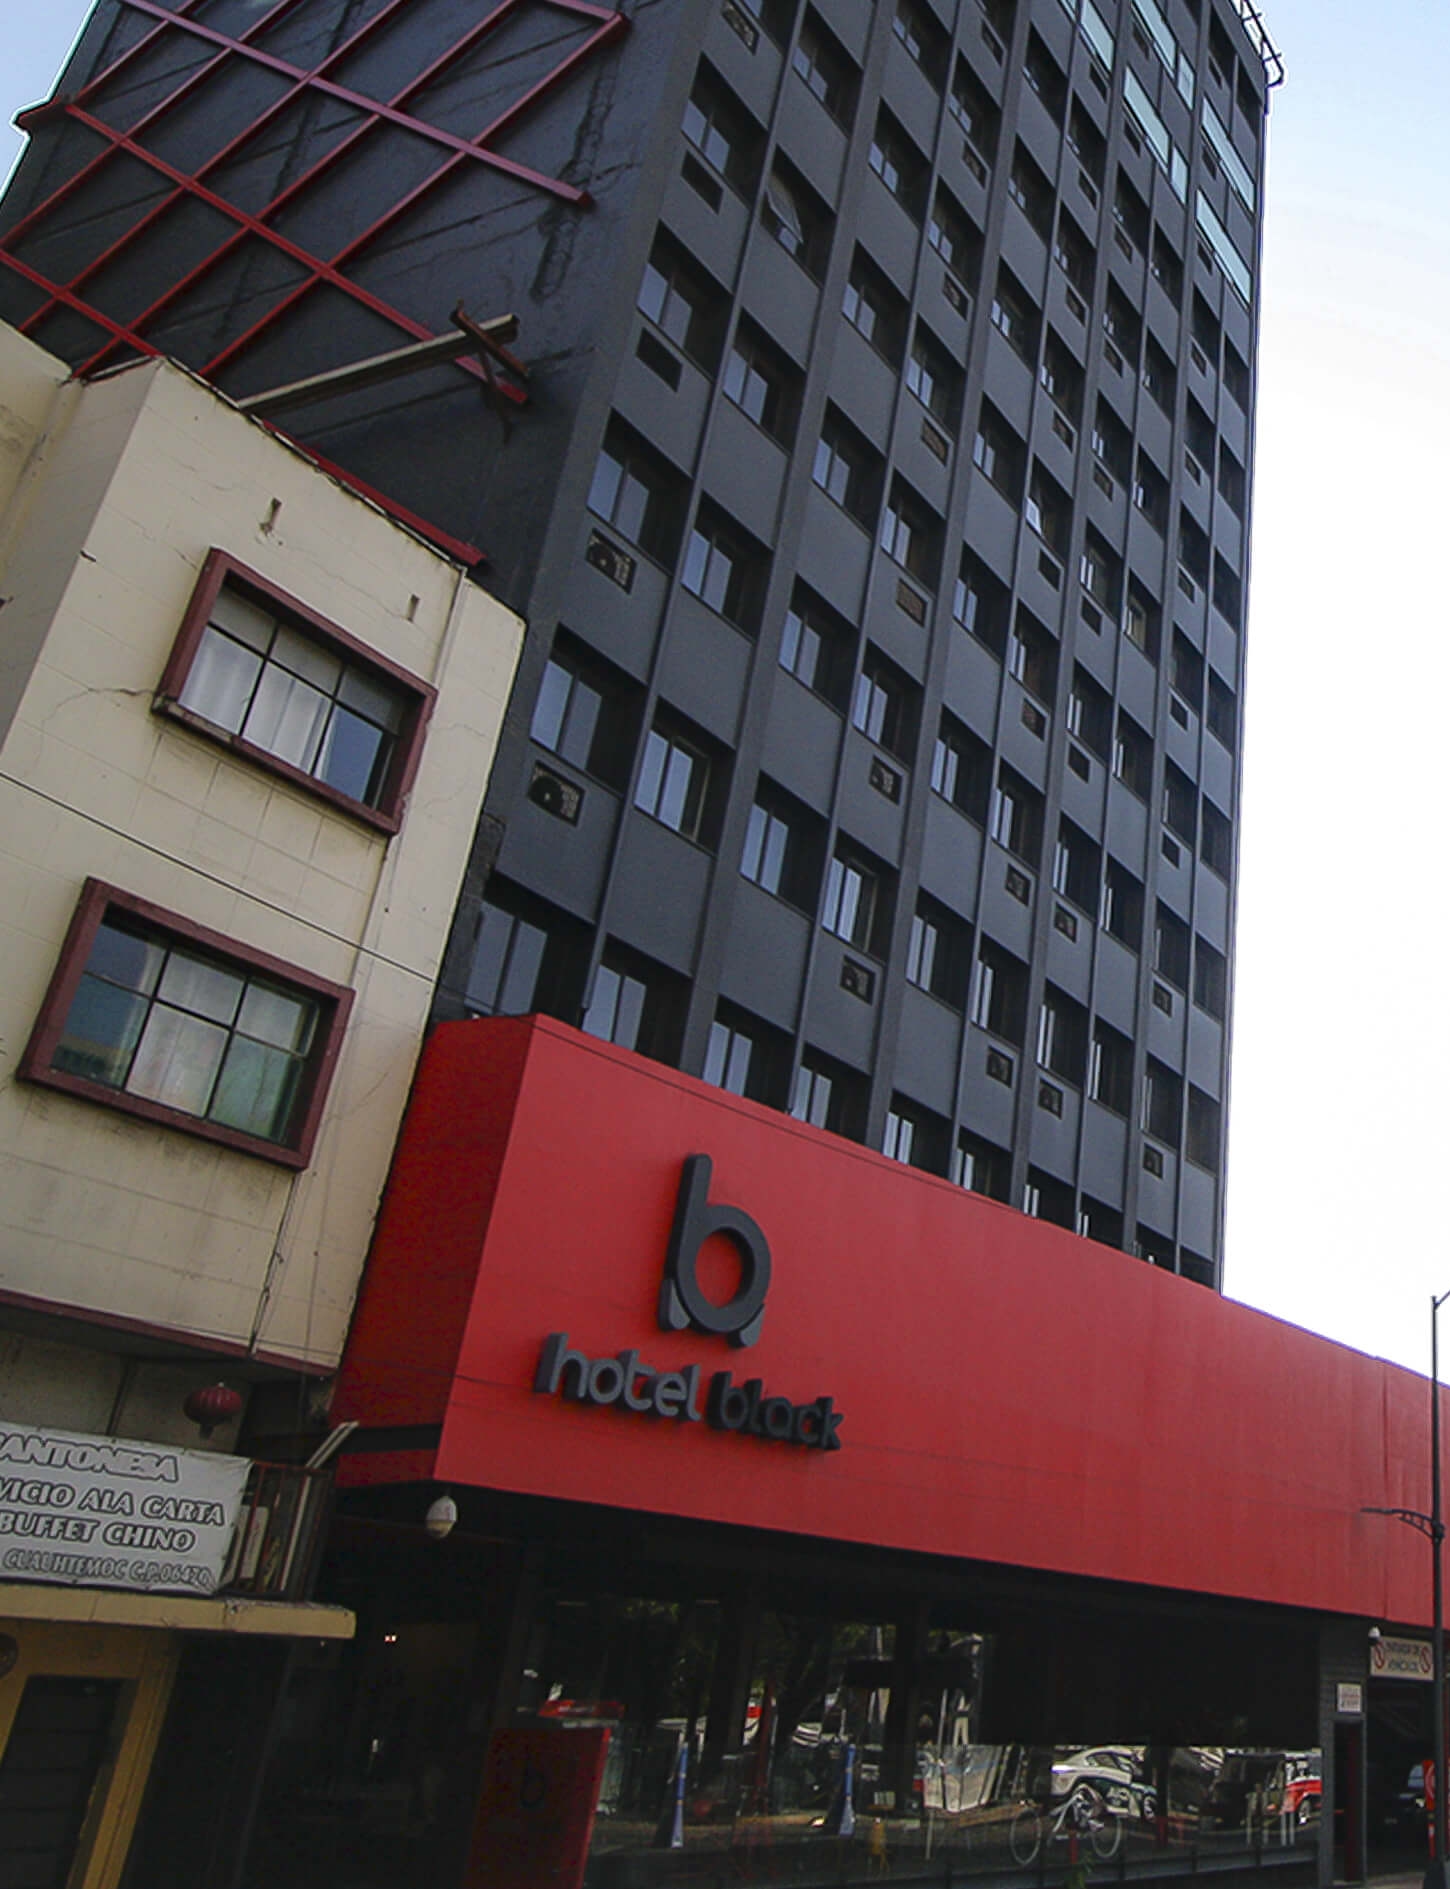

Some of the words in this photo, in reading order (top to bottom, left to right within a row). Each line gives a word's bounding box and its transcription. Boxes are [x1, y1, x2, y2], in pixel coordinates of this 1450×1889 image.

[533, 1332, 702, 1421] hotel
[705, 1371, 844, 1450] black
[0, 1432, 179, 1485] ANTONESA
[0, 1509, 100, 1543] BUFFET
[102, 1522, 196, 1552] CHINO
[141, 1495, 225, 1526] CARTA
